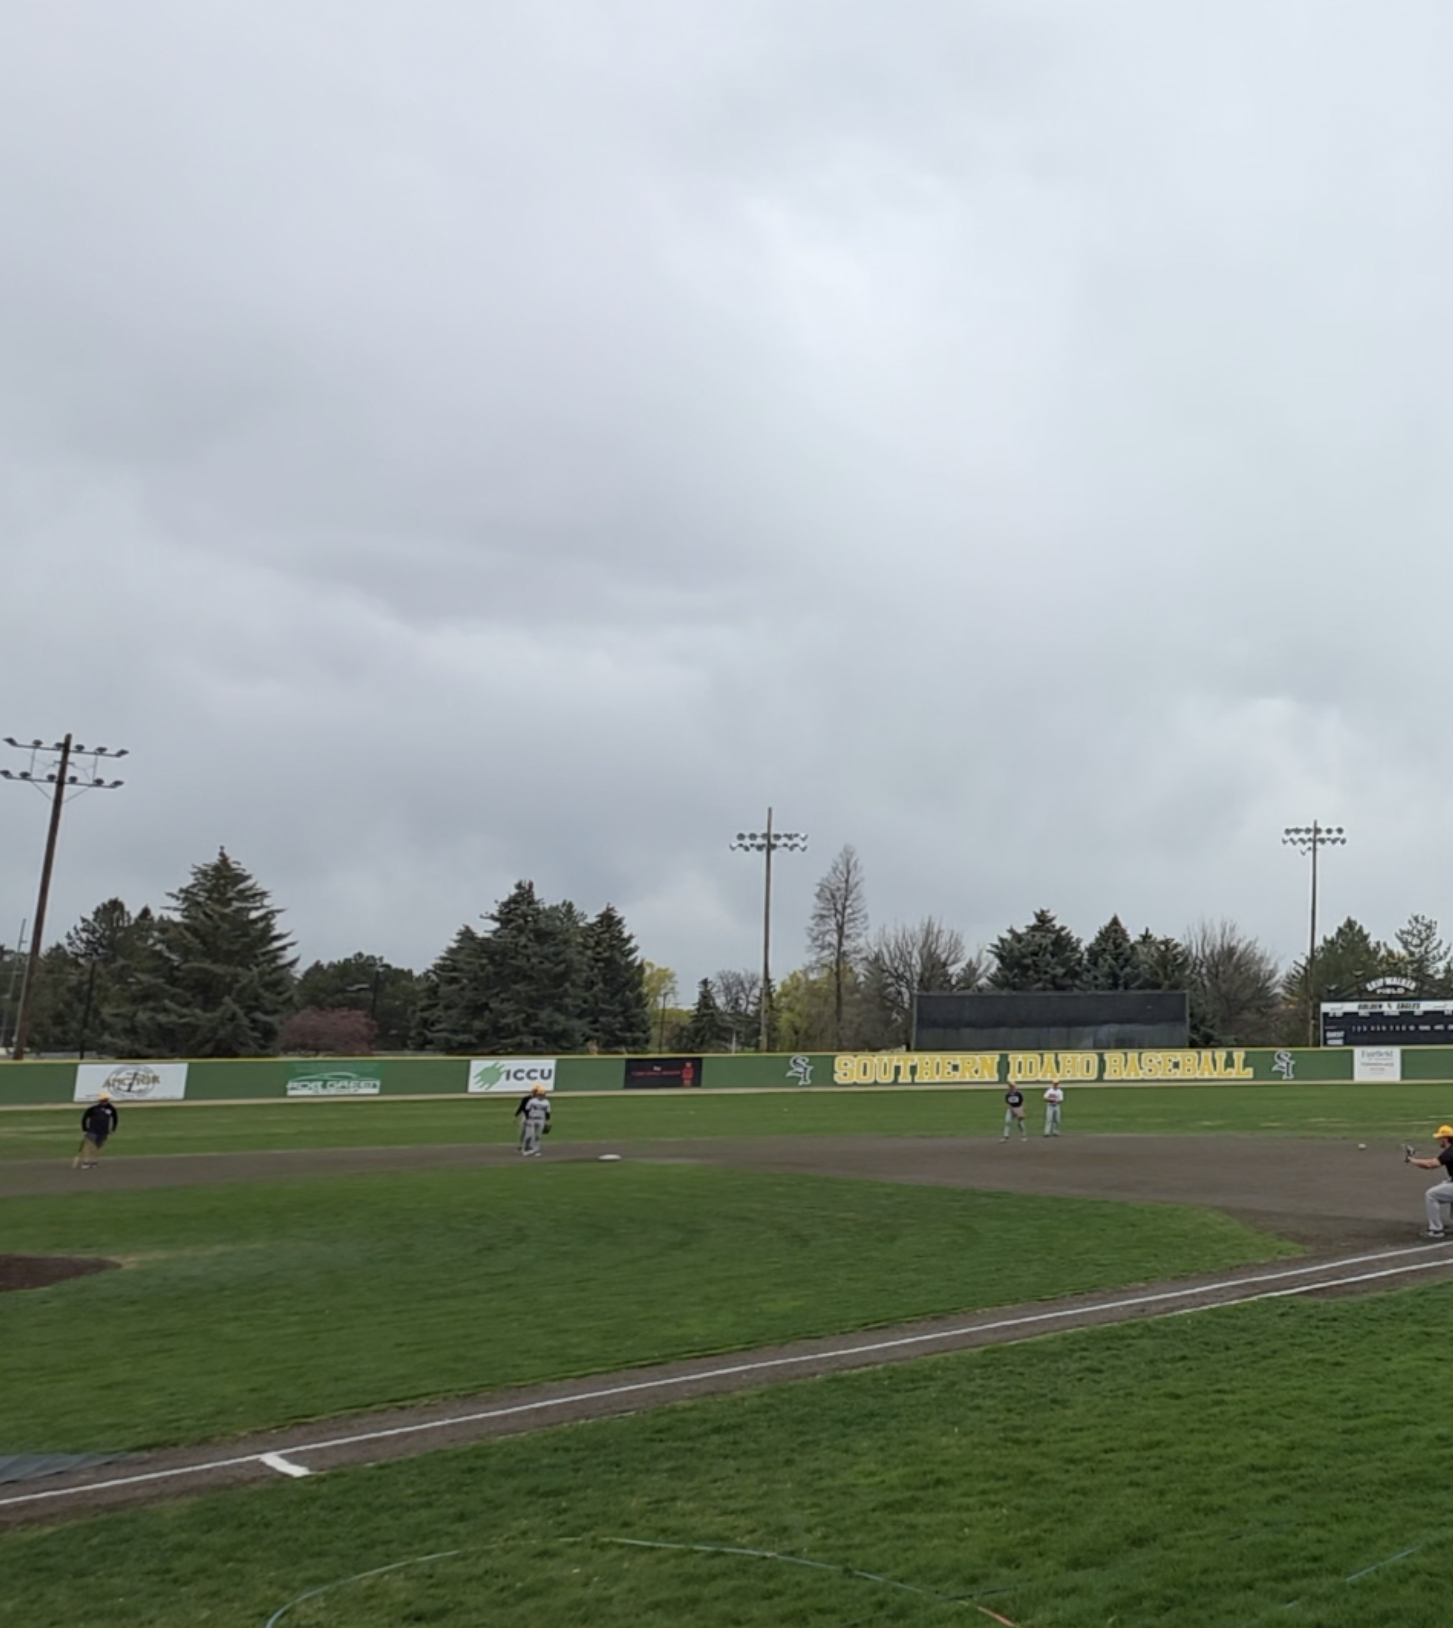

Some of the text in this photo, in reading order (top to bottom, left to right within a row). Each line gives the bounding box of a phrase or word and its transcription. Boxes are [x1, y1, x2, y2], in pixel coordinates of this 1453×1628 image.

[505, 1068, 553, 1082] ICCU
[834, 1050, 1254, 1084] SOUTHERN IDAHO BASEBALL
